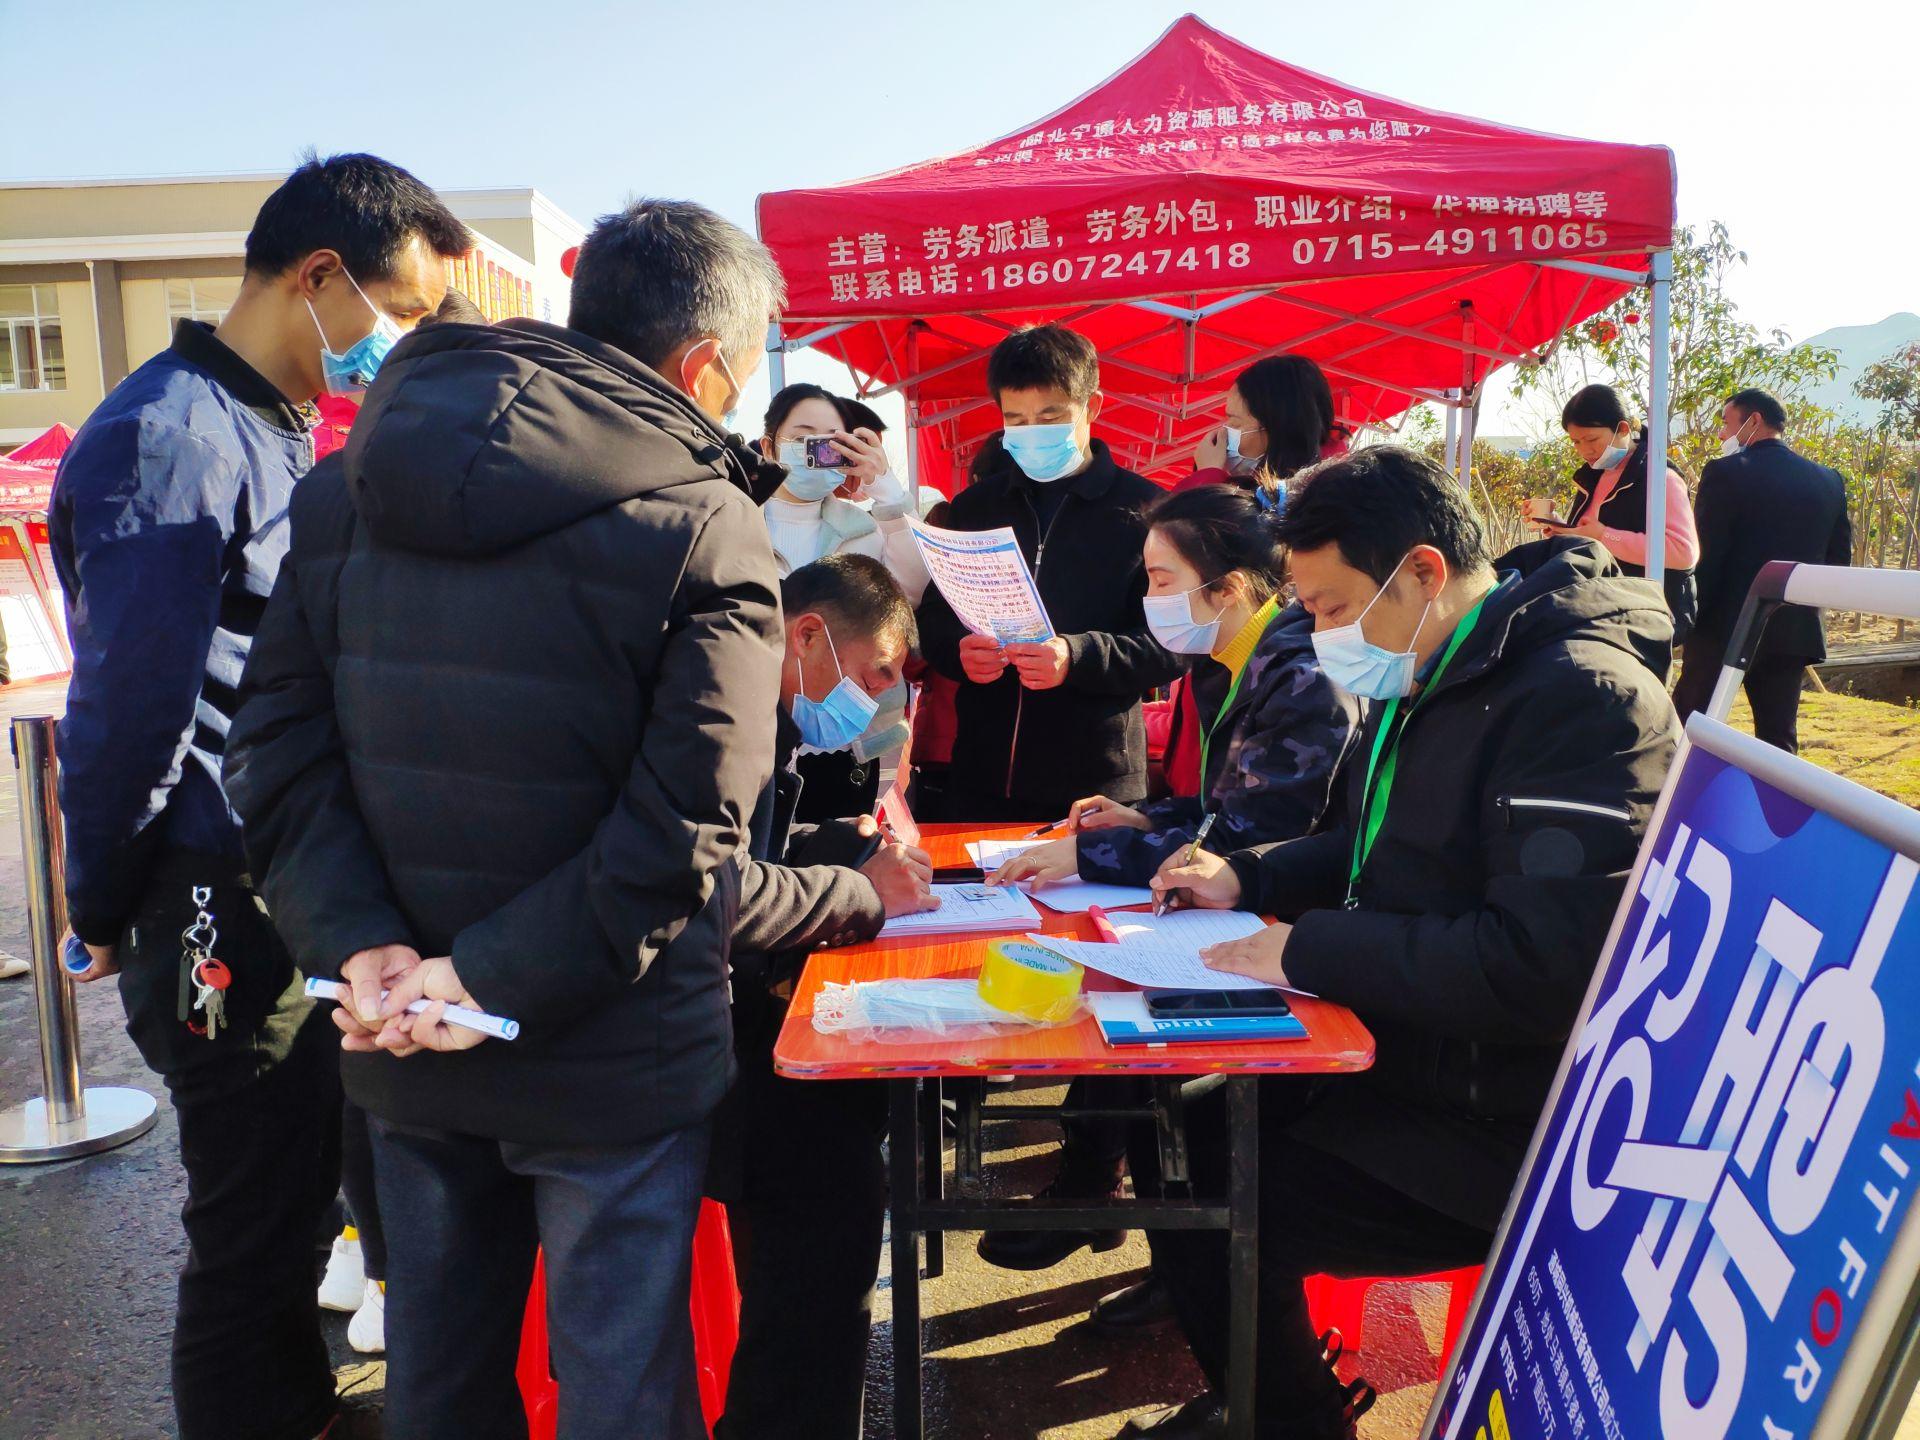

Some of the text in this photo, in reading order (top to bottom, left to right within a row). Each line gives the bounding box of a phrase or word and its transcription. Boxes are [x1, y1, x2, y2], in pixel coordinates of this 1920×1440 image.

[1292, 222, 1609, 266] 0715-4911065
[1782, 1058, 1920, 1404] AIT FOR
